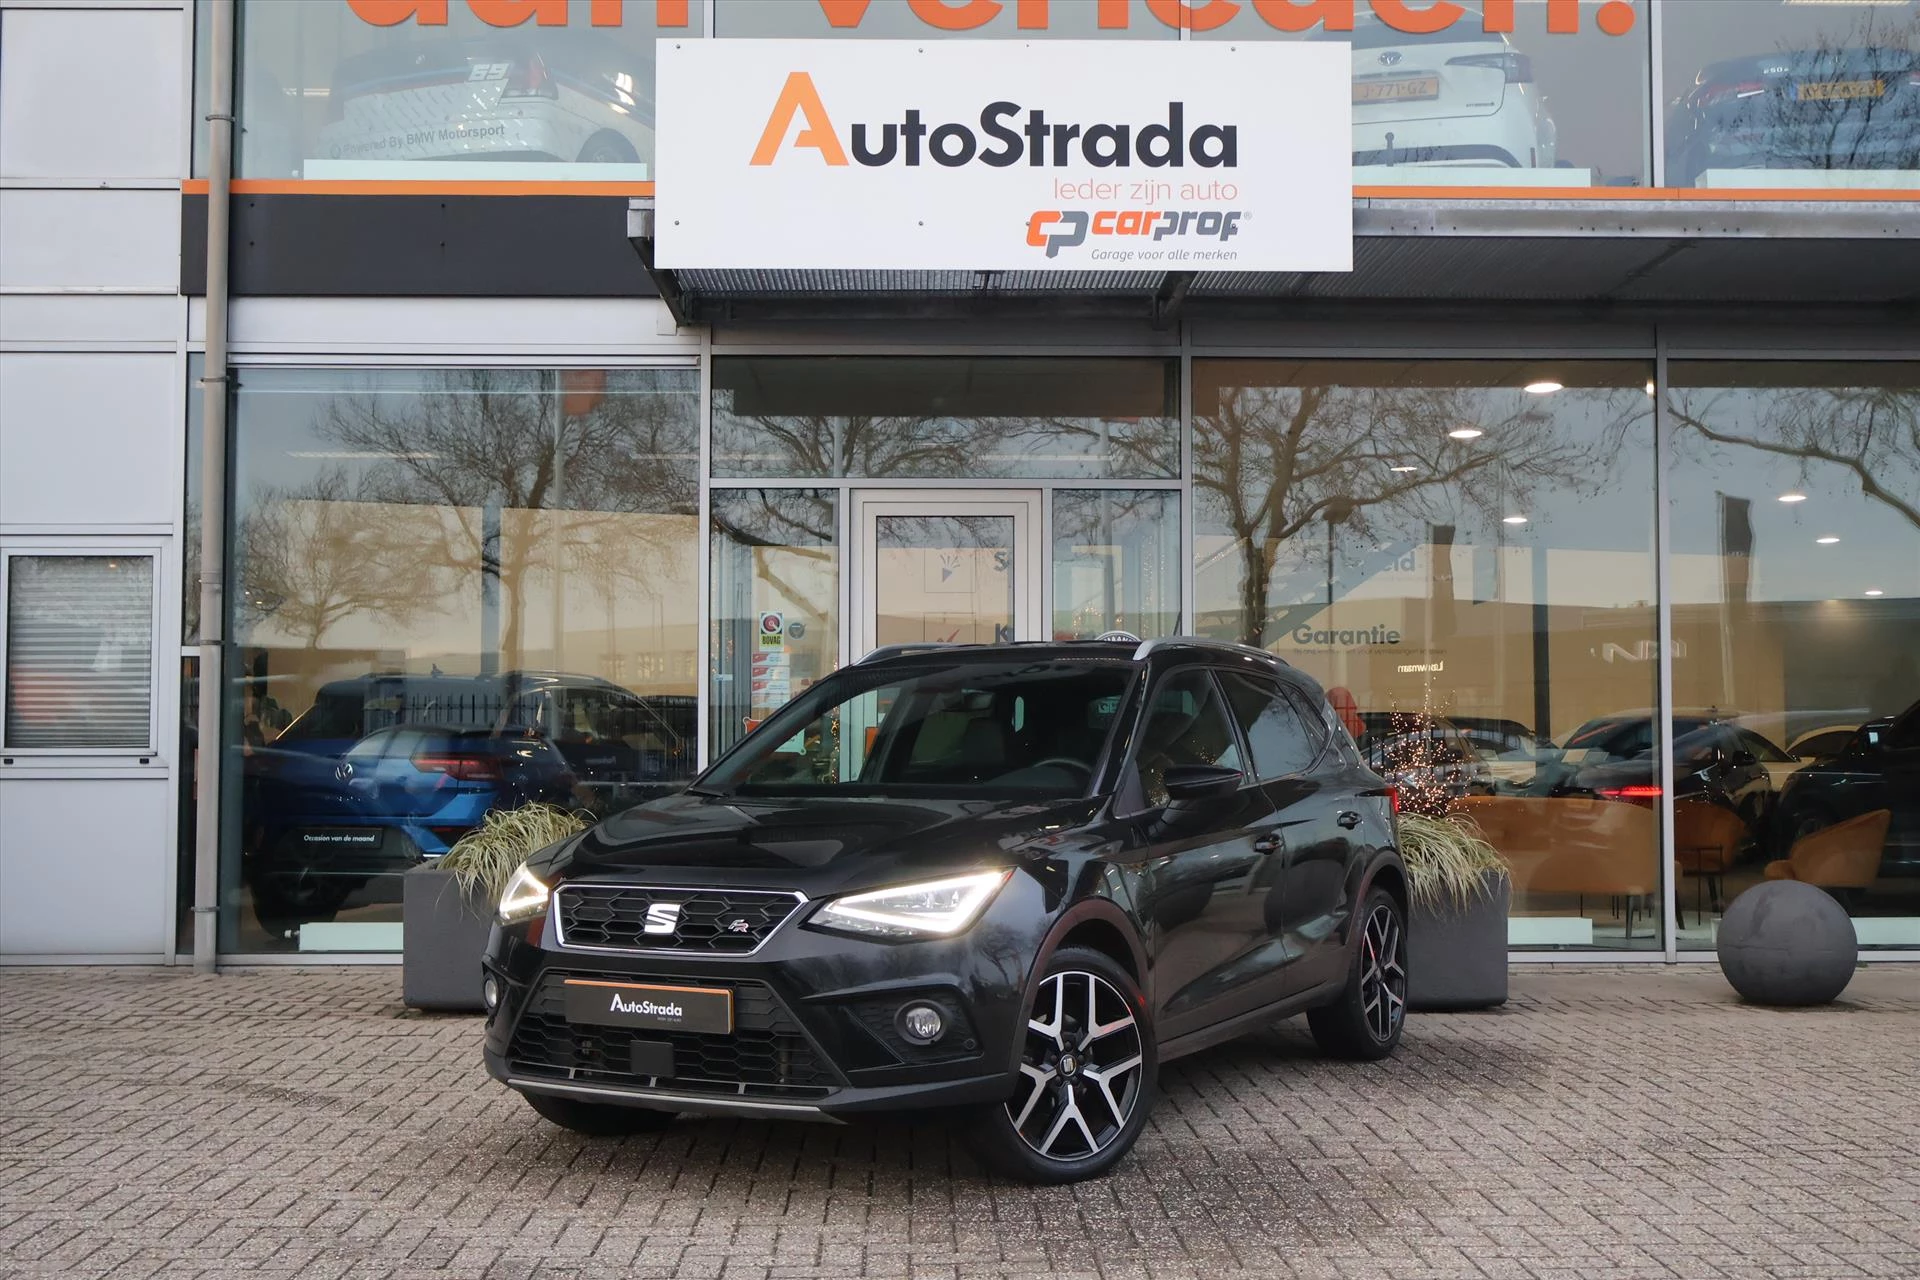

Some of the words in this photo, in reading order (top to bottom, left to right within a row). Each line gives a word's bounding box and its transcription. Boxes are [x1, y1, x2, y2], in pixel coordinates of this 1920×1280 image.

[468, 63, 509, 81] 69
[749, 71, 1238, 168] AutoStrada
[389, 136, 403, 149] By
[406, 131, 435, 146] BMW
[438, 124, 505, 142] Motorsport
[1054, 178, 1122, 200] Ieder
[1130, 179, 1171, 205] zijn
[1180, 180, 1238, 200] auto
[1091, 249, 1134, 262] Garage
[1138, 252, 1164, 261] voor
[1167, 249, 1190, 261] alle
[1193, 249, 1237, 261] merken
[1292, 623, 1400, 645] Garantie
[303, 834, 330, 842] Occasion
[343, 834, 351, 842] de
[352, 834, 375, 842] maand
[610, 993, 682, 1017] AutoStrada
